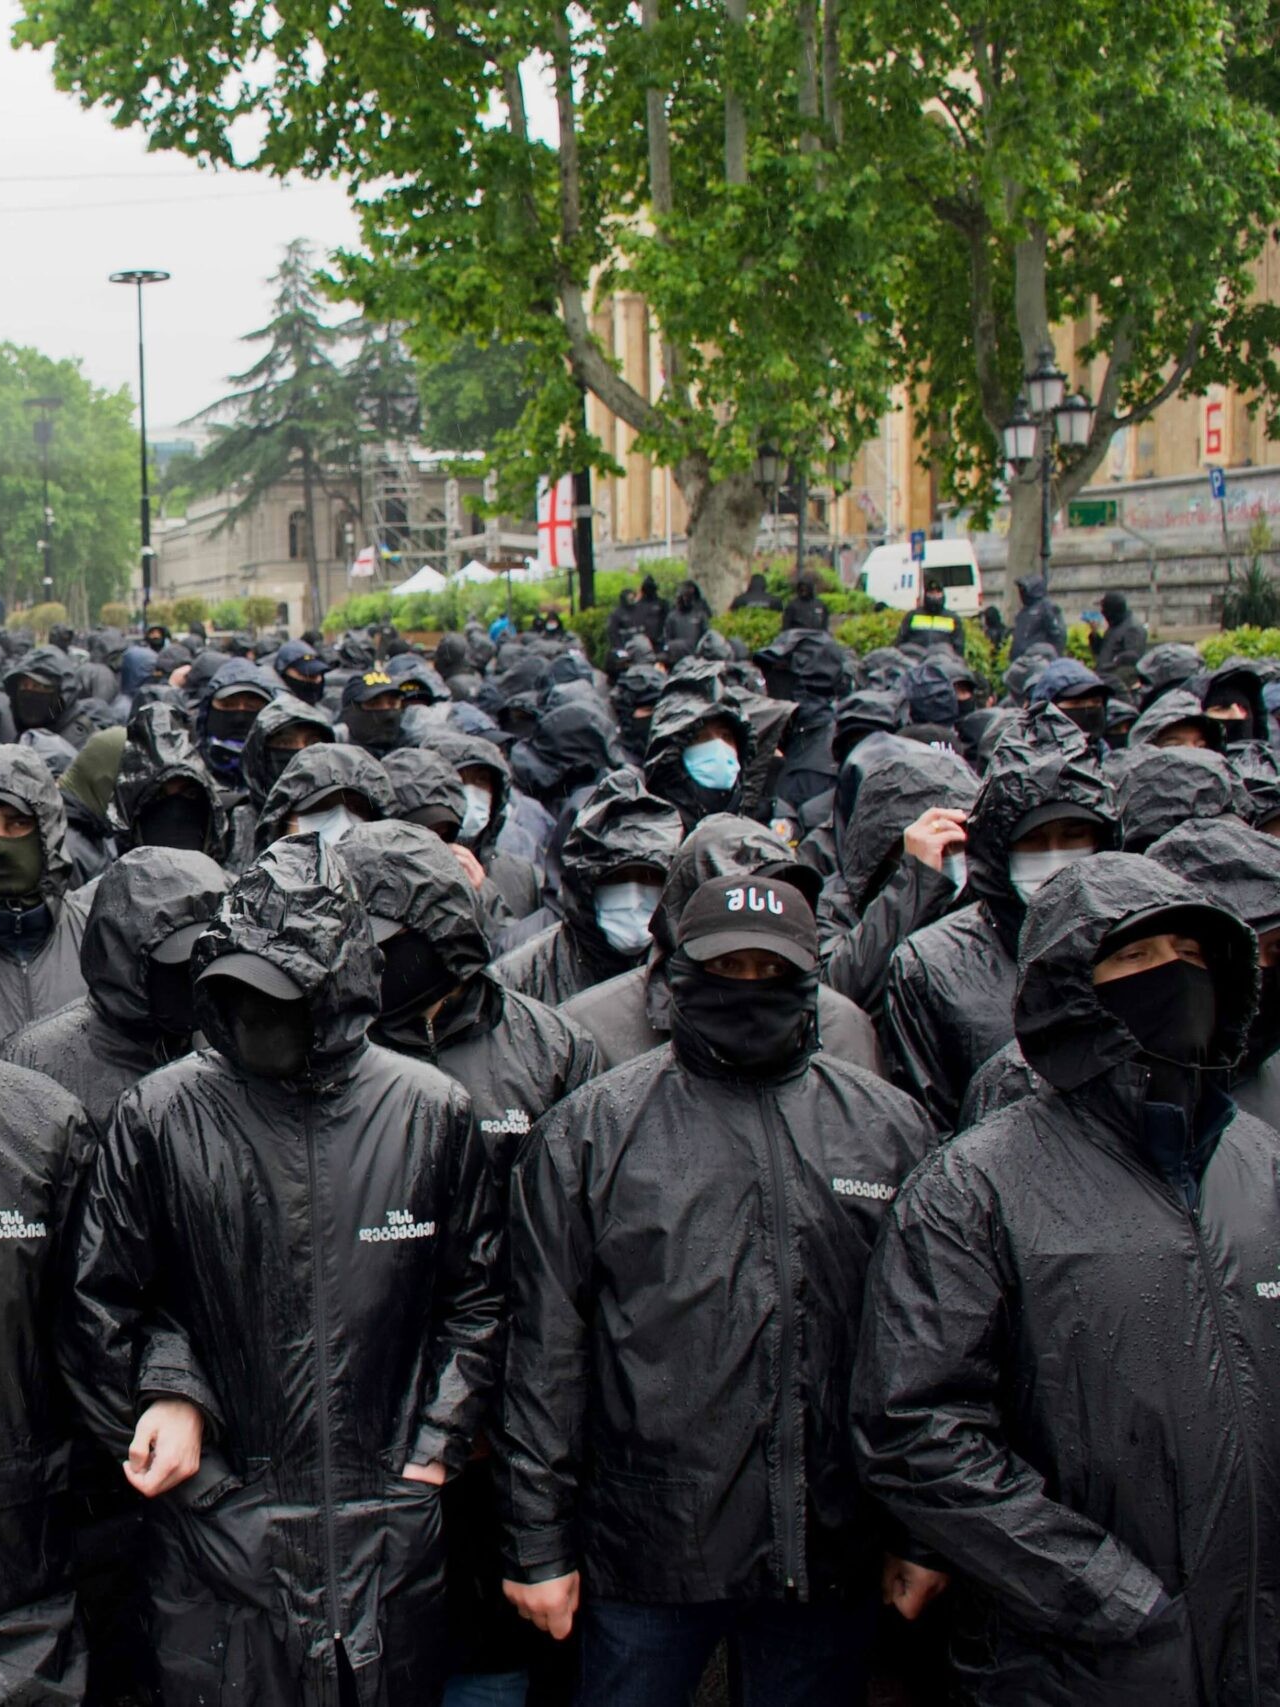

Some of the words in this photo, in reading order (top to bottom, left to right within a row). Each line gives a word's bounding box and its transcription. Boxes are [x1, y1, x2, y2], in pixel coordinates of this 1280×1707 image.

[1213, 471, 1222, 496] P
[725, 887, 783, 914] შსს
[385, 1208, 414, 1225] შსს
